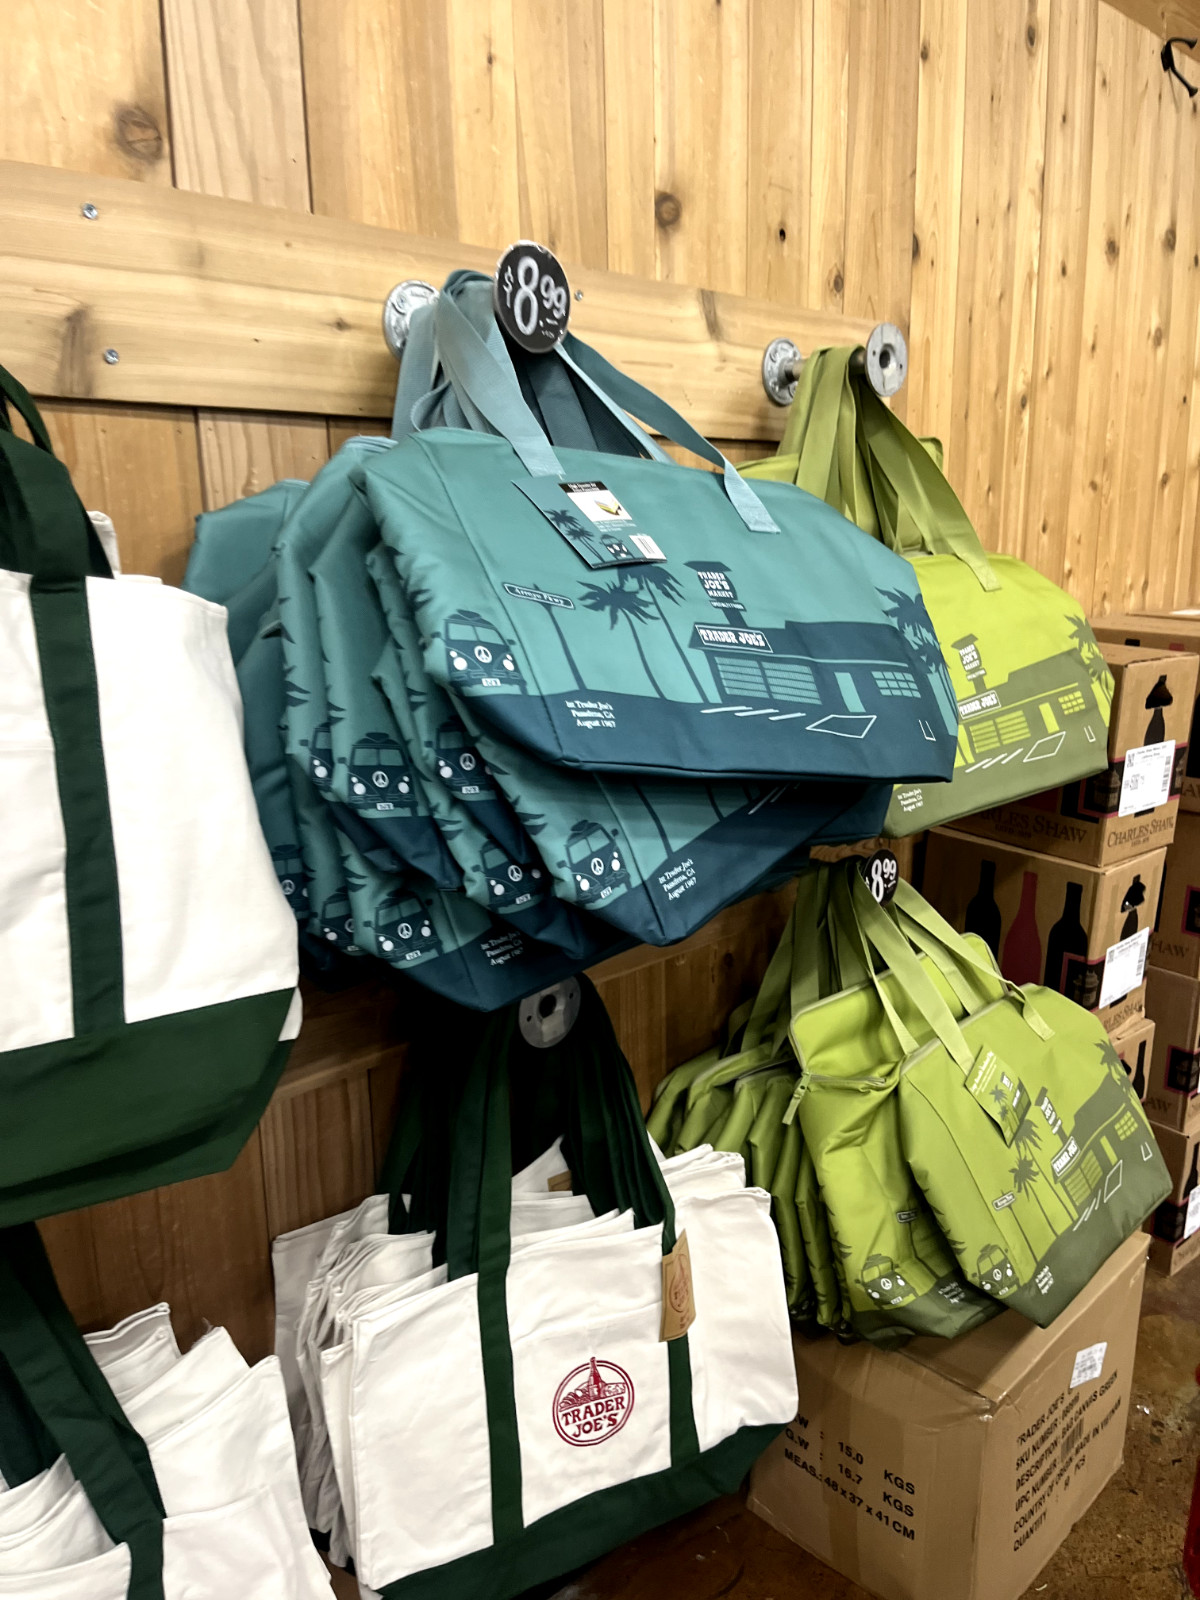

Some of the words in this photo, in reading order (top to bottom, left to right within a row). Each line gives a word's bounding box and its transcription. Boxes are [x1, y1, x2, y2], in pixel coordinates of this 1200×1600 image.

[697, 571, 727, 581] TRADER
[704, 579, 730, 591] JOE'S
[706, 590, 734, 599] MARKET
[699, 629, 739, 644] TRADER
[738, 631, 766, 647] JOE'S
[1031, 814, 1087, 844] SHAW
[1107, 824, 1150, 848] CHARLES
[685, 867, 696, 877] CA
[668, 885, 686, 900] August
[560, 1395, 626, 1427] TRADER
[572, 1412, 619, 1438] JOE'S
[1016, 1413, 1045, 1446] TRADER
[838, 1442, 864, 1465] 15.0
[884, 1469, 915, 1495] KGS
[1016, 1448, 1031, 1471] SKU
[824, 1476, 839, 1492] 48
[849, 1492, 864, 1507] 37
[838, 1463, 863, 1485] 16.7
[883, 1491, 914, 1517] KGS
[1015, 1490, 1031, 1512] UPC
[1013, 1494, 1046, 1534] COUNTRY
[1013, 1509, 1047, 1551] QUANTITY
